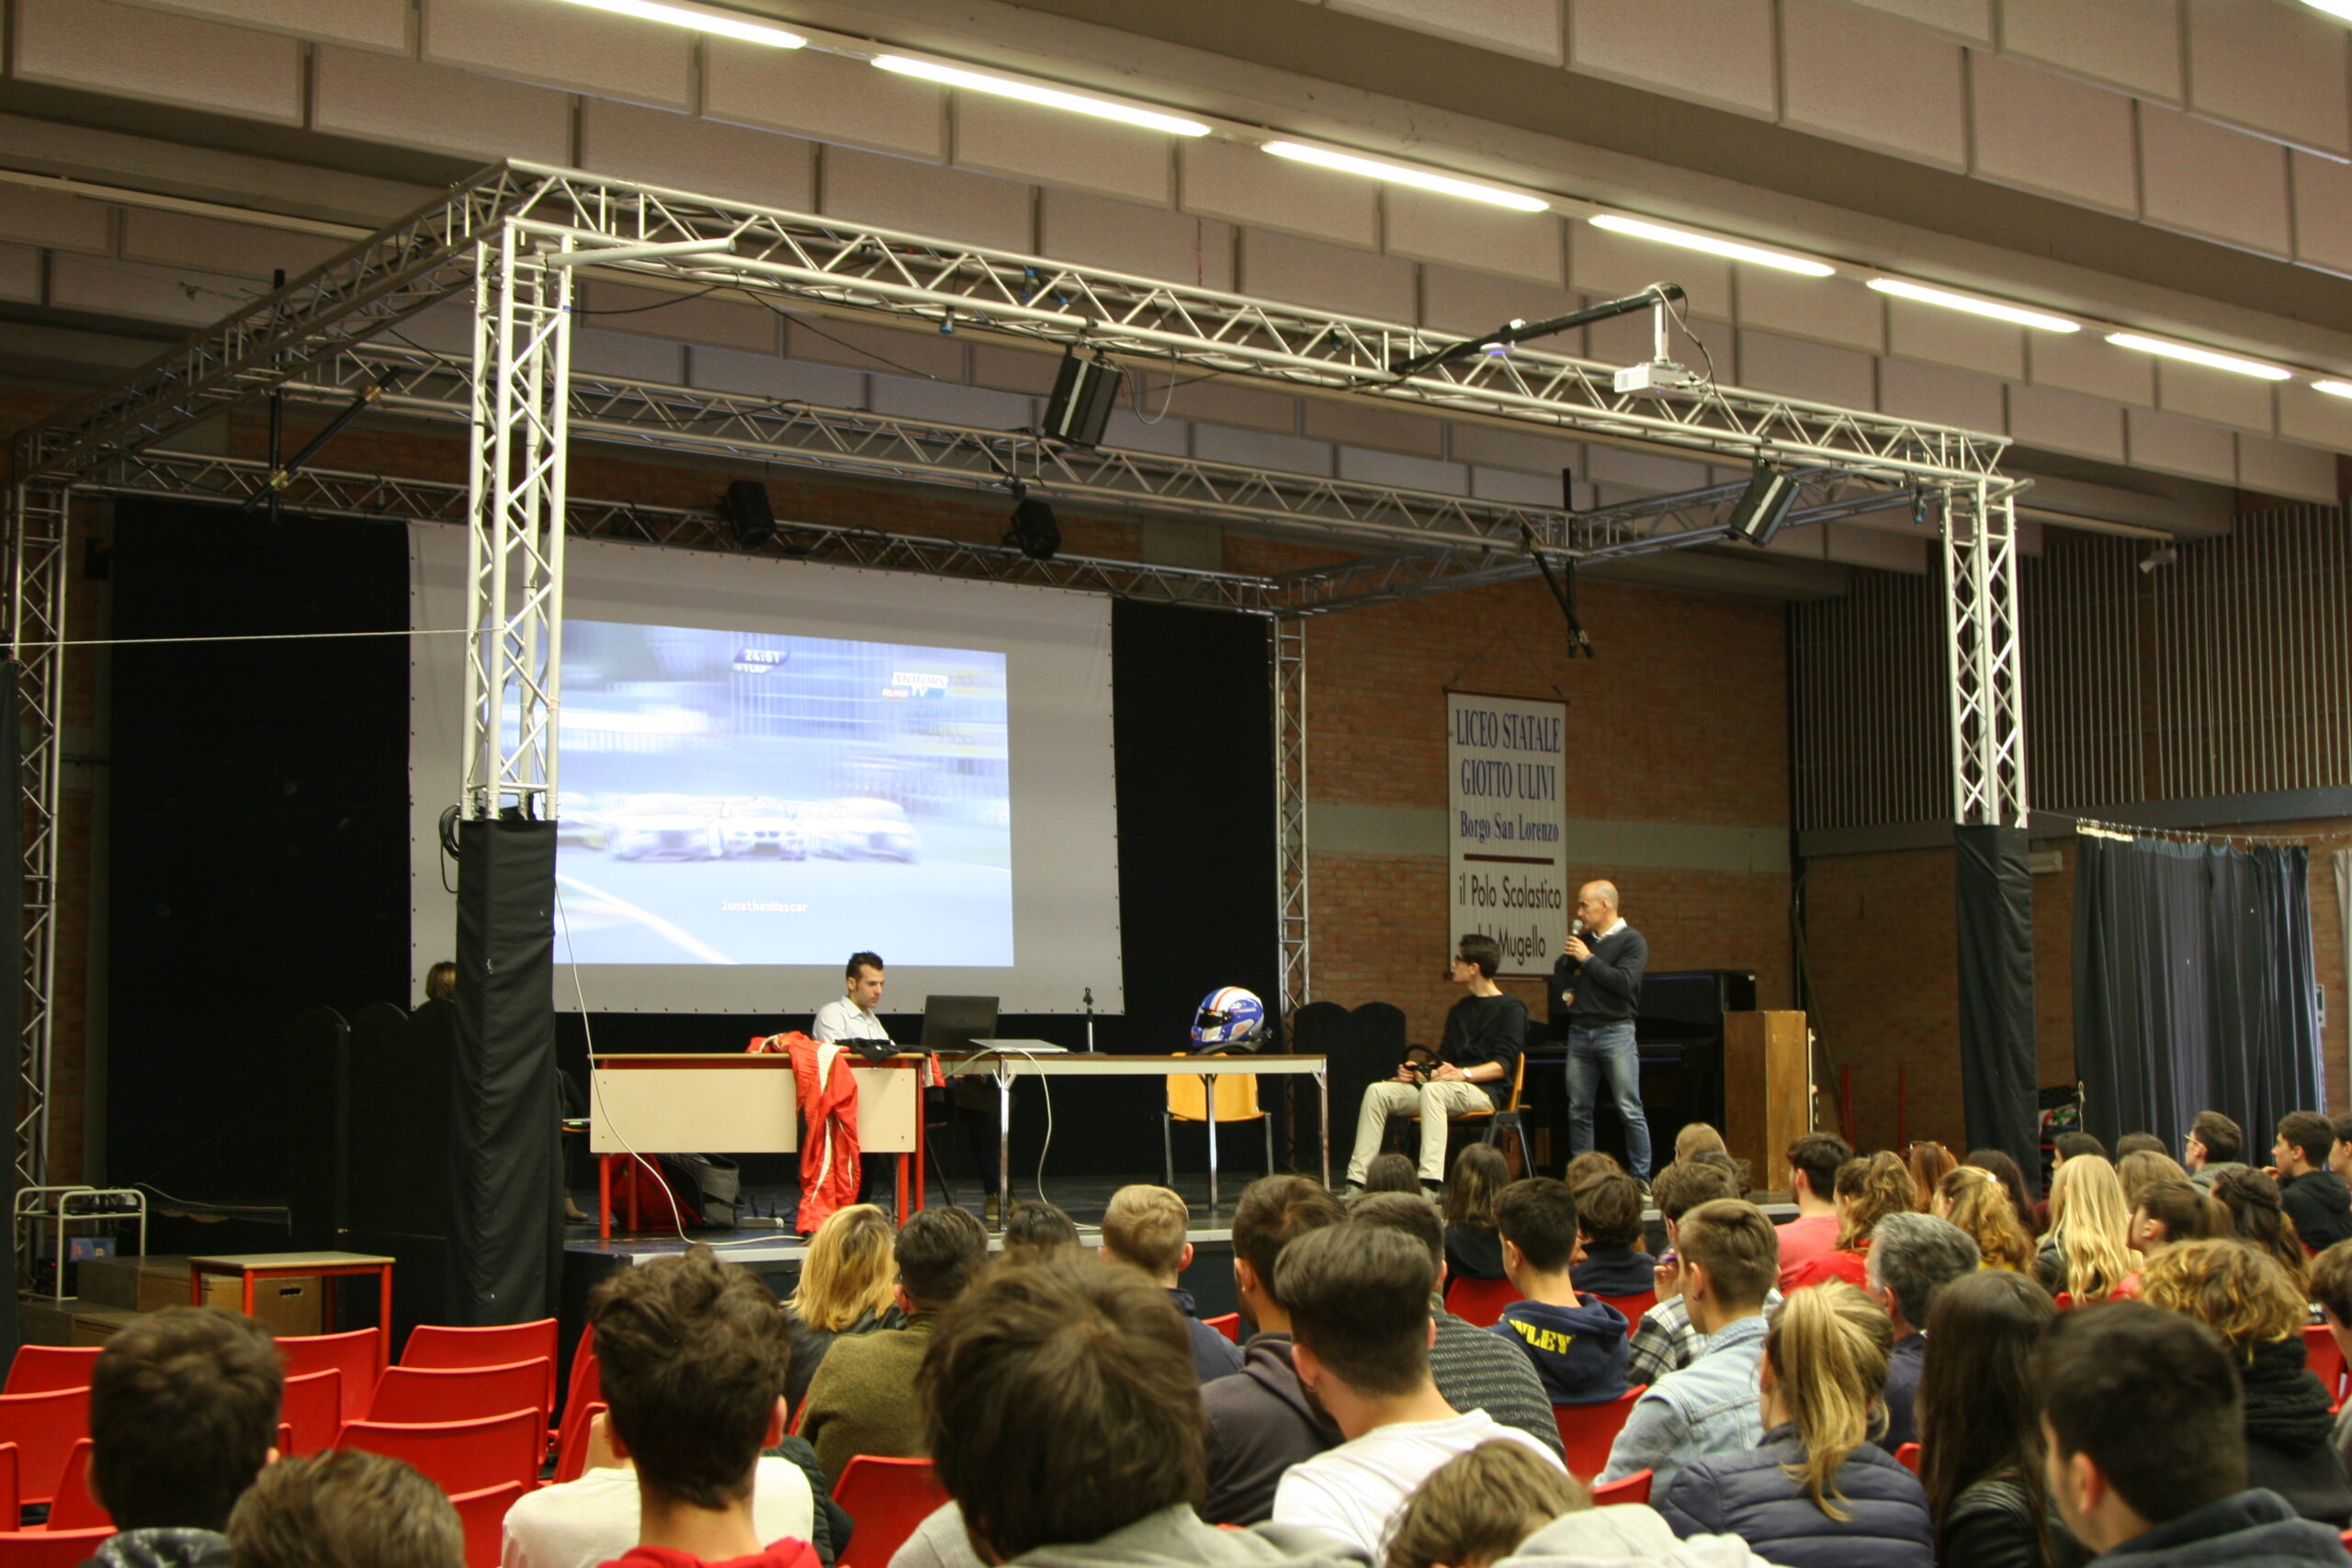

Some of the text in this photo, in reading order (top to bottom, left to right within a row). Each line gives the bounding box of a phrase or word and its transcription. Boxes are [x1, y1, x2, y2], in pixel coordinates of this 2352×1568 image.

[895, 673, 945, 686] MOTORS
[1455, 709, 1561, 753] LICEO STATALE
[1461, 759, 1555, 801] GIOTTO ULIVI
[1460, 810, 1559, 843] Borgo San Lorenzo
[1459, 872, 1561, 909] il Polo Scolastico
[1498, 924, 1546, 966] Mugello
